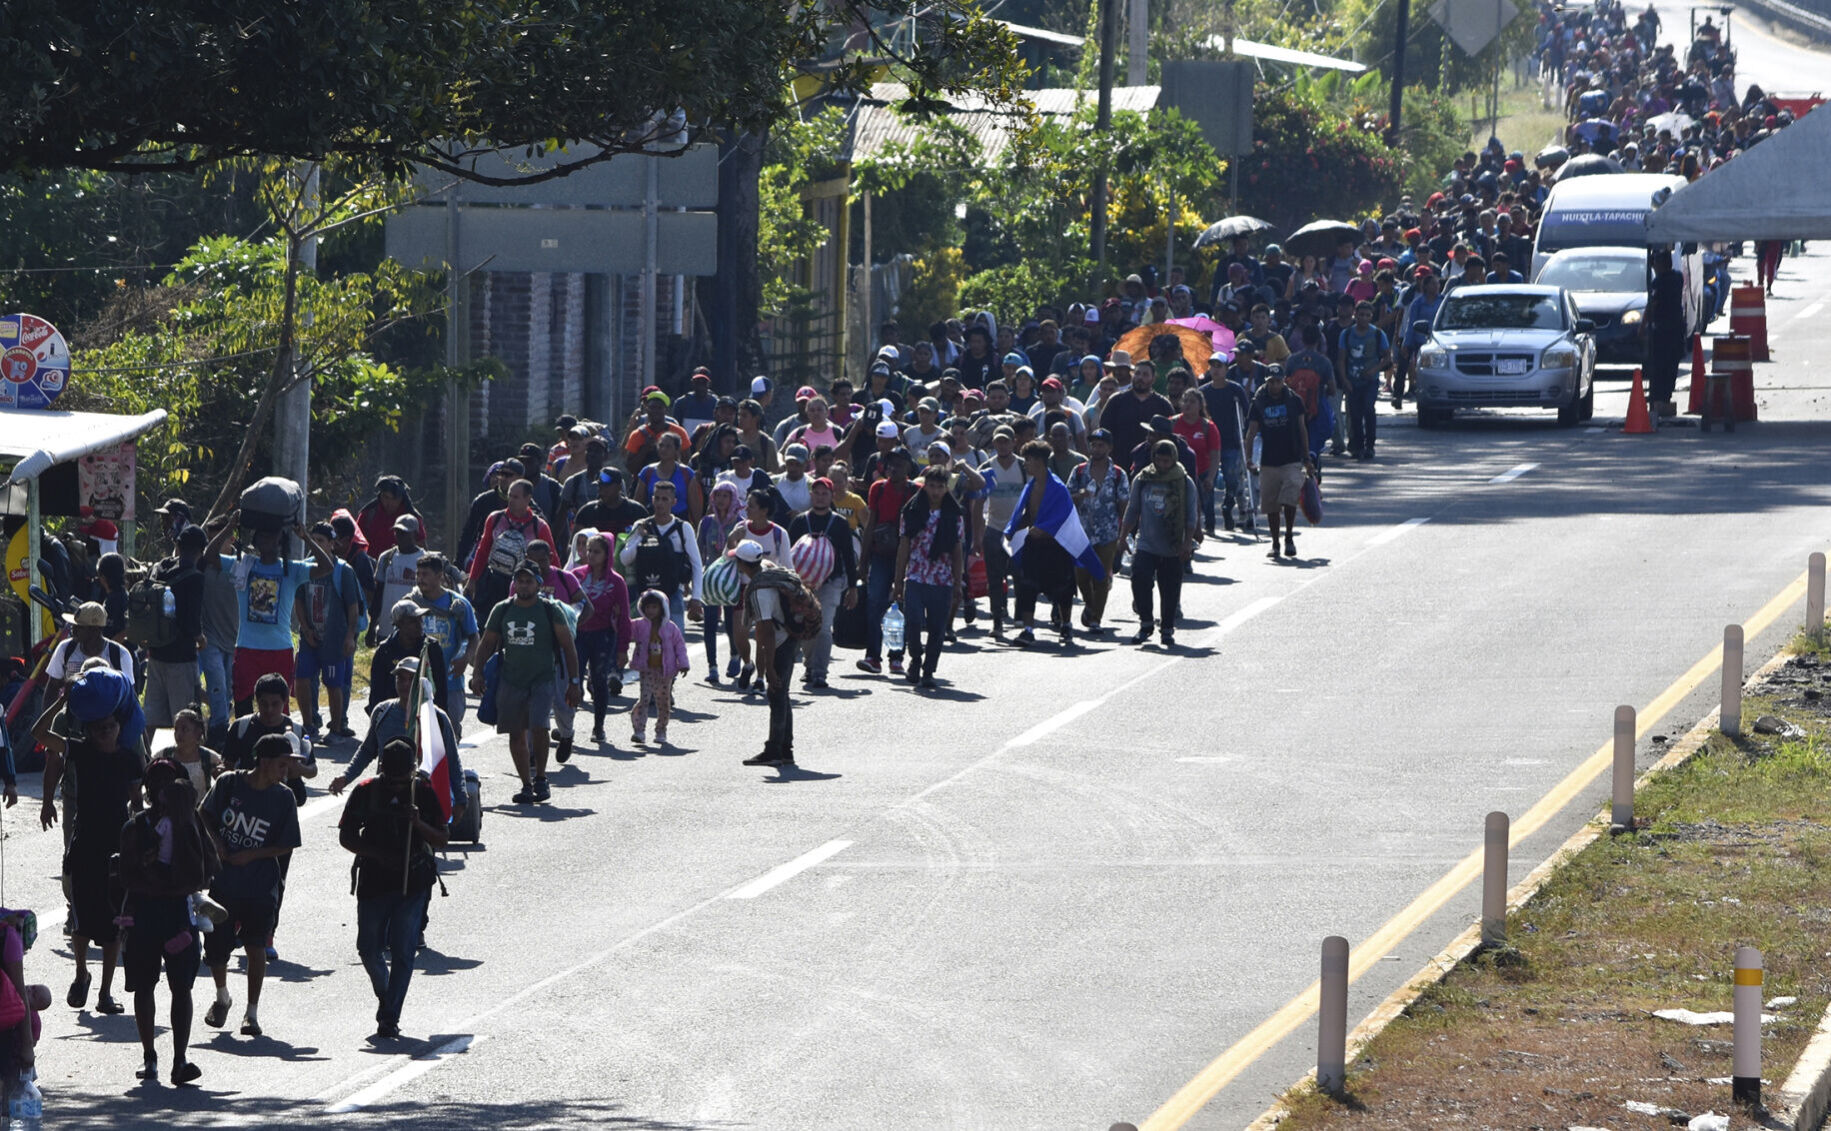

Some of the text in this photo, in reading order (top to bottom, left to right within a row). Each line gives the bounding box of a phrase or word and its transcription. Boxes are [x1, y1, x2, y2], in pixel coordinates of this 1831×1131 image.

[1562, 212, 1645, 222] HUIXTLA-TAPACHU
[11, 569, 30, 580] Sabri
[222, 808, 271, 841] ONE
